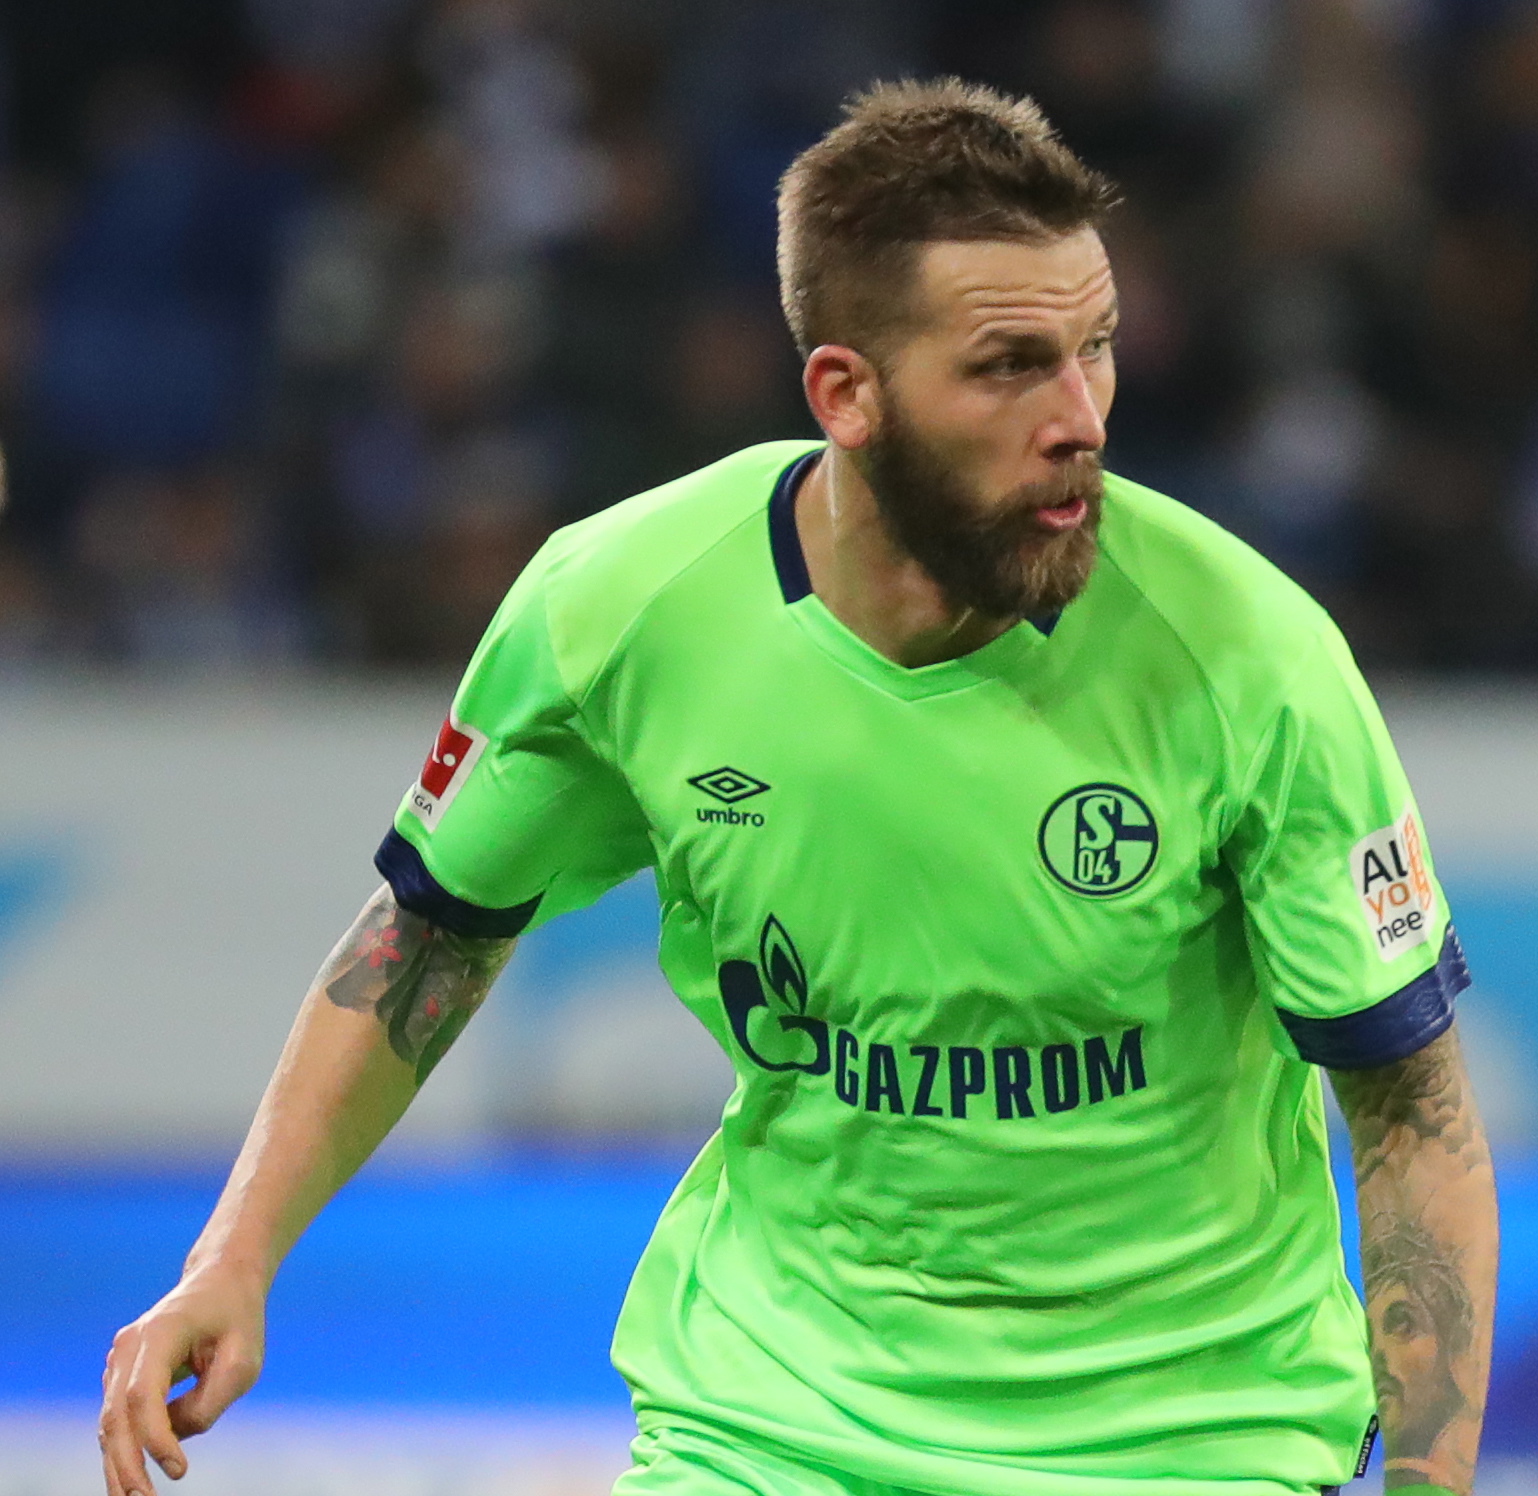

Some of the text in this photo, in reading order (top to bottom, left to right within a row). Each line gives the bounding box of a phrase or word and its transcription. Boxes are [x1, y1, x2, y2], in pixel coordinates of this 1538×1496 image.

[696, 806, 765, 828] umbro
[1376, 910, 1424, 948] nee
[834, 1025, 1148, 1121] GAZPROM
